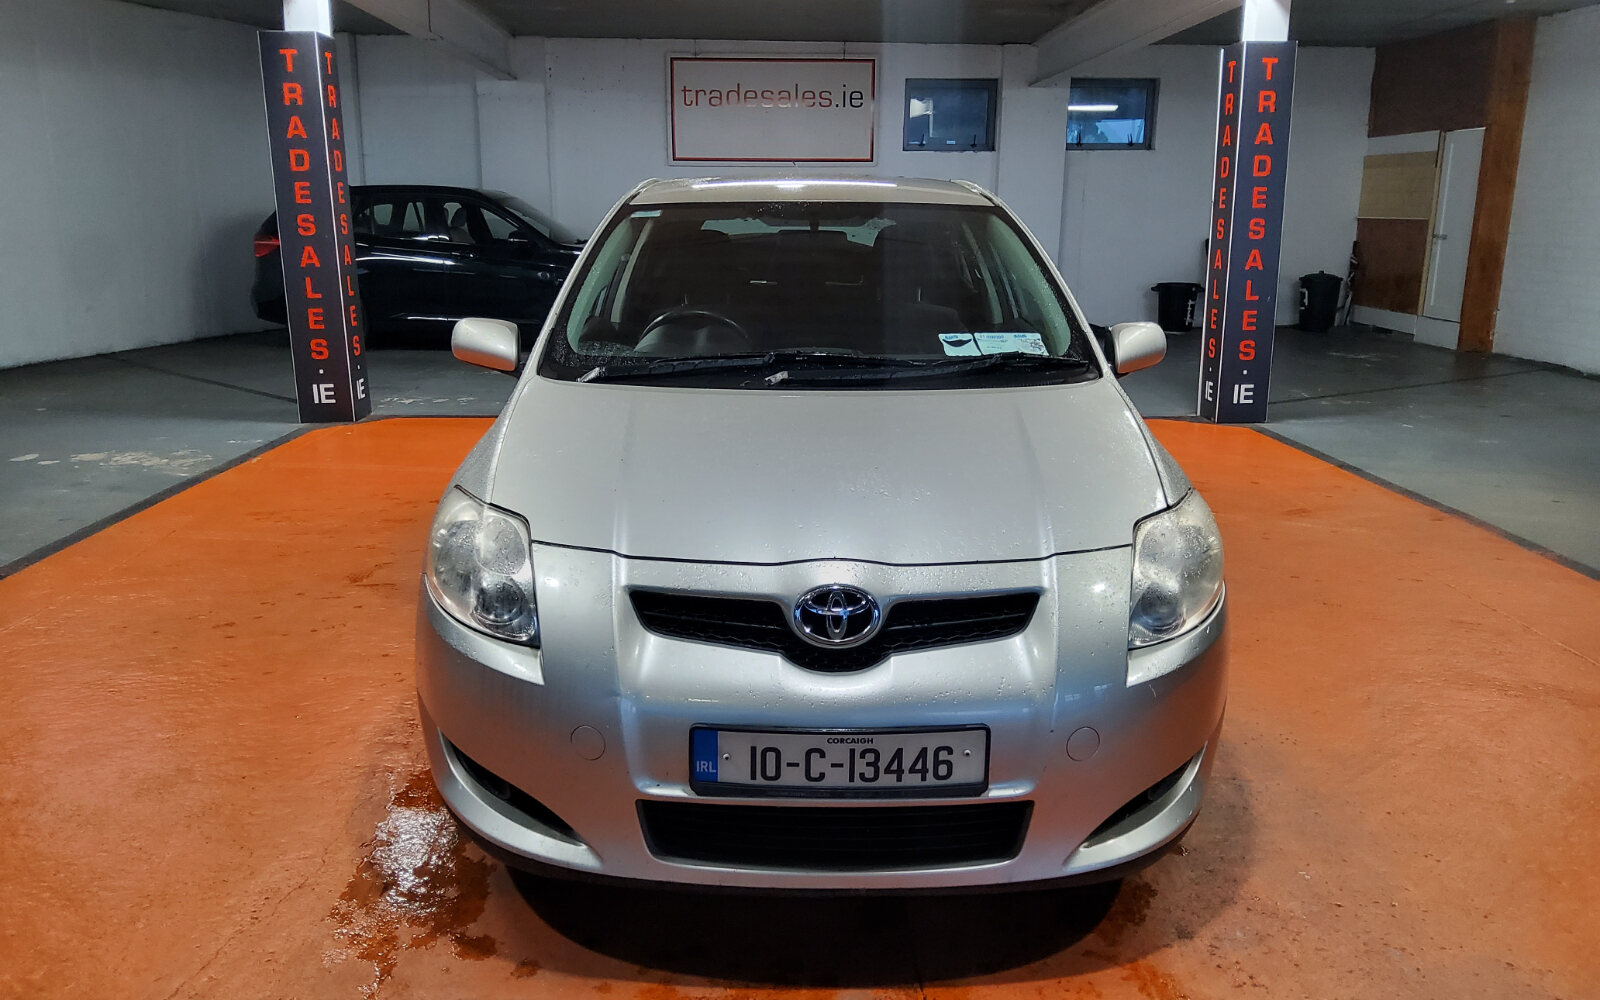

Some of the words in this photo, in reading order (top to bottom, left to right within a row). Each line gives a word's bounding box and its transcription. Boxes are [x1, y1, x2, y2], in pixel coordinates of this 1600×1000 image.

[681, 83, 865, 109] tradesales.ie
[826, 737, 874, 745] CORCAIGH
[696, 760, 717, 773] IRL
[750, 746, 954, 783] 10-C-13446
